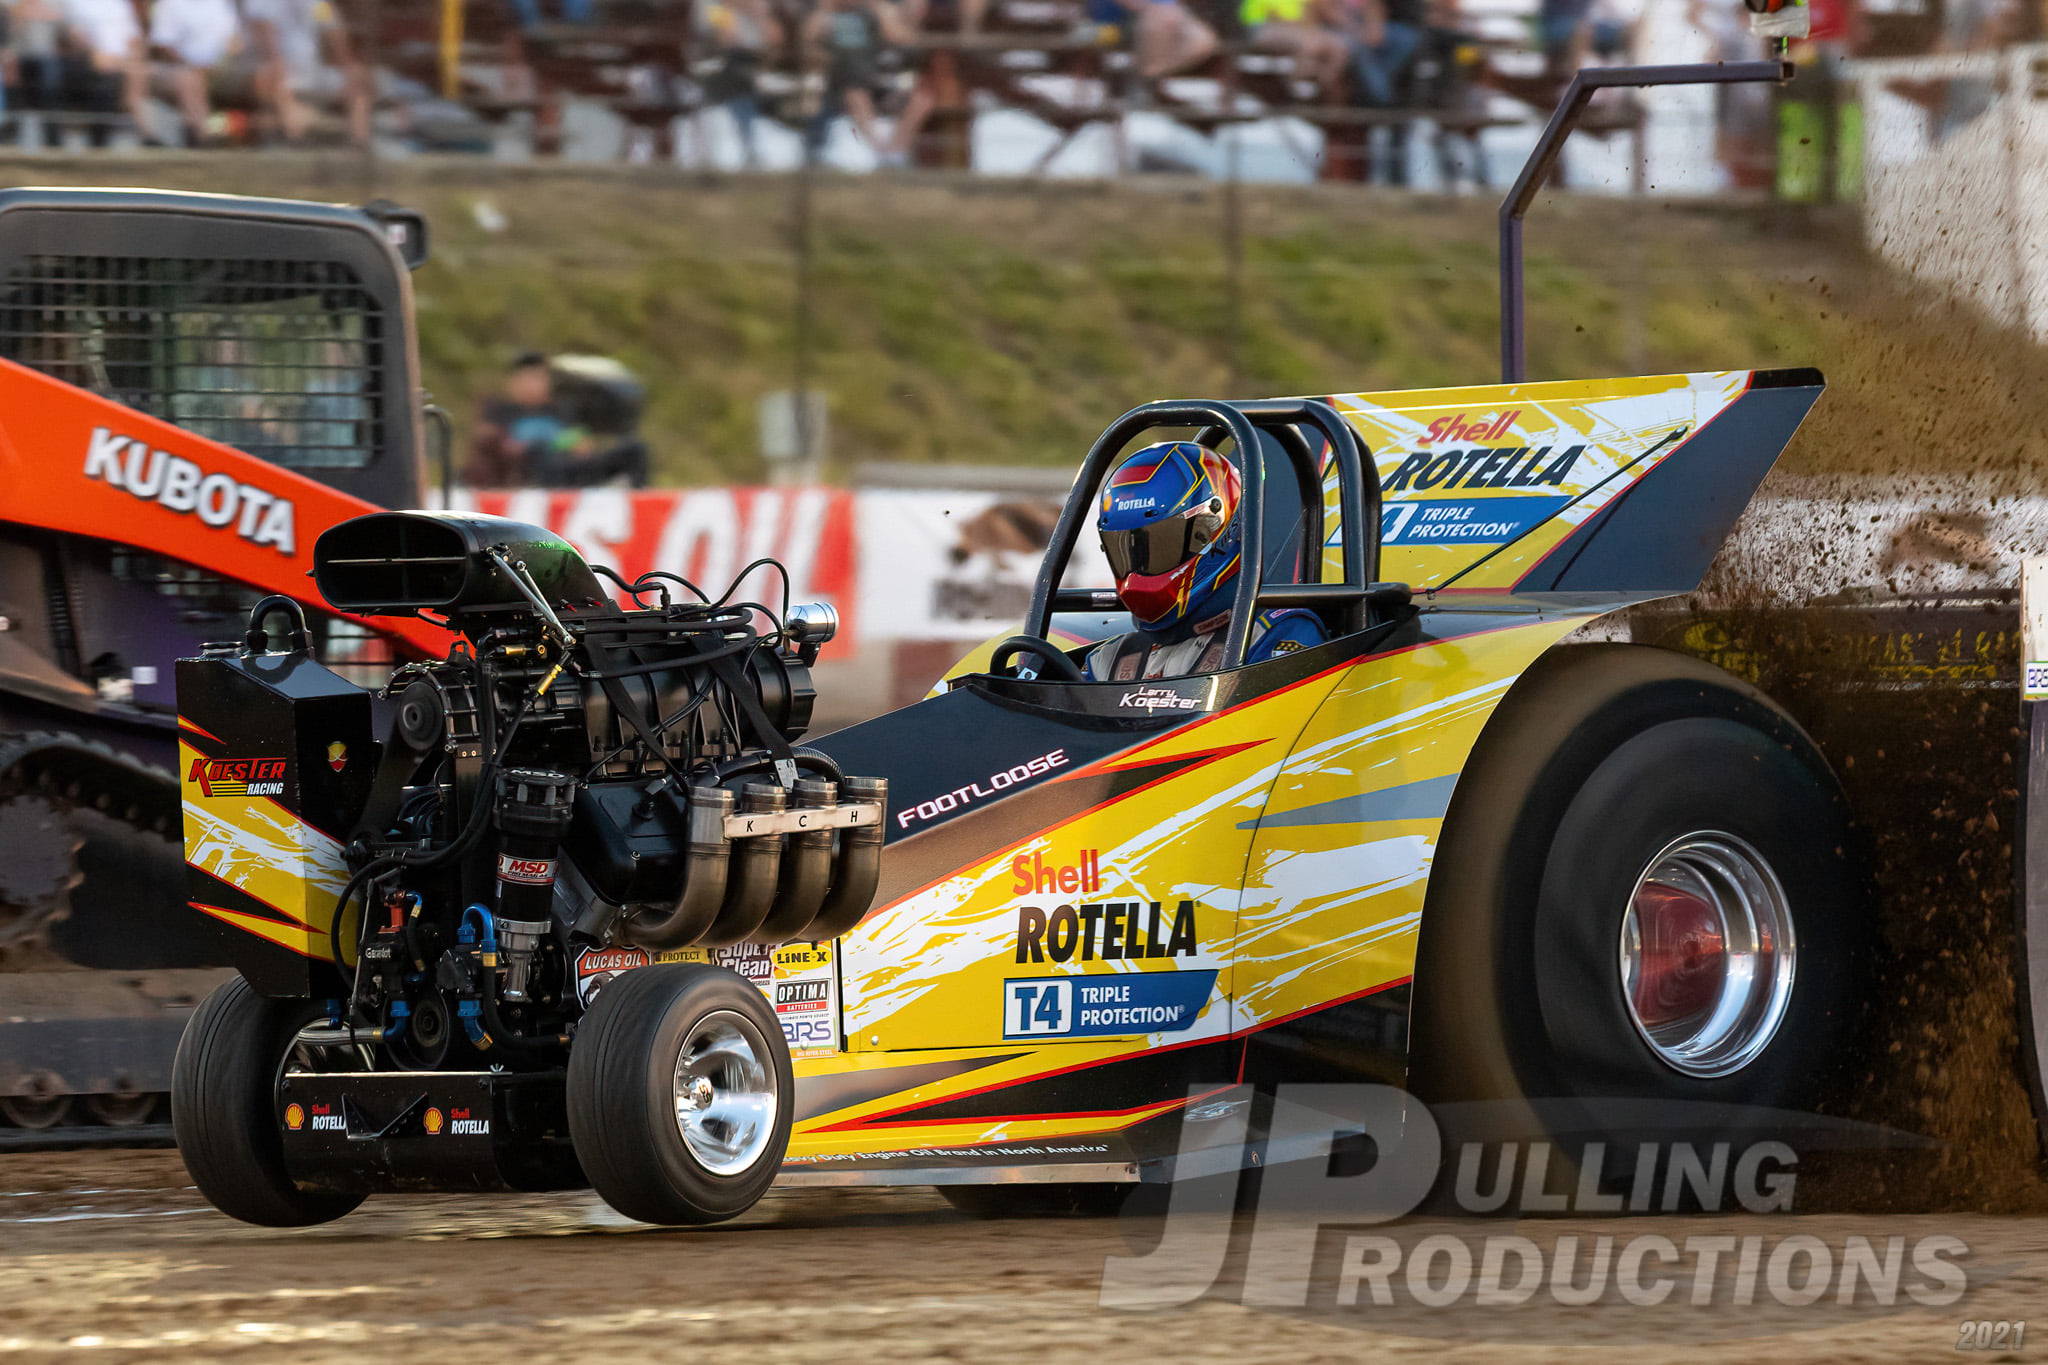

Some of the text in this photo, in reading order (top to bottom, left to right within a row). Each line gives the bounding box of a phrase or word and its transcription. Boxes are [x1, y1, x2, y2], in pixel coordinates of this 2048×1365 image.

[1417, 410, 1521, 444] Shell
[1381, 445, 1587, 492] ROTELLA
[84, 427, 294, 554] KUBOTA
[1118, 497, 1156, 511] ROTELLA
[1421, 506, 1475, 521] TRIPLE
[1138, 686, 1176, 697] Larry
[1119, 693, 1202, 709] Koester
[247, 782, 284, 795] RACING
[897, 748, 1069, 829] FOOTLOOSE
[746, 811, 858, 832] K C H
[509, 860, 549, 874] MSD
[1012, 849, 1099, 895] Shell
[1015, 900, 1197, 964] ROTELLA
[585, 952, 642, 970] LUCAS OIL
[662, 951, 701, 961] PROTECT
[778, 983, 826, 1001] OPTIMA
[1081, 986, 1130, 1003] TRIPLE
[1015, 985, 1062, 1031] T4
[312, 1104, 330, 1114] Shell
[451, 1108, 470, 1119] Shell
[451, 1120, 489, 1134] ROTELLA
[817, 1153, 856, 1162] Duty
[855, 1150, 909, 1161] Engine
[934, 1148, 981, 1156] Brand
[980, 1148, 999, 1156] in
[998, 1146, 1044, 1156] North
